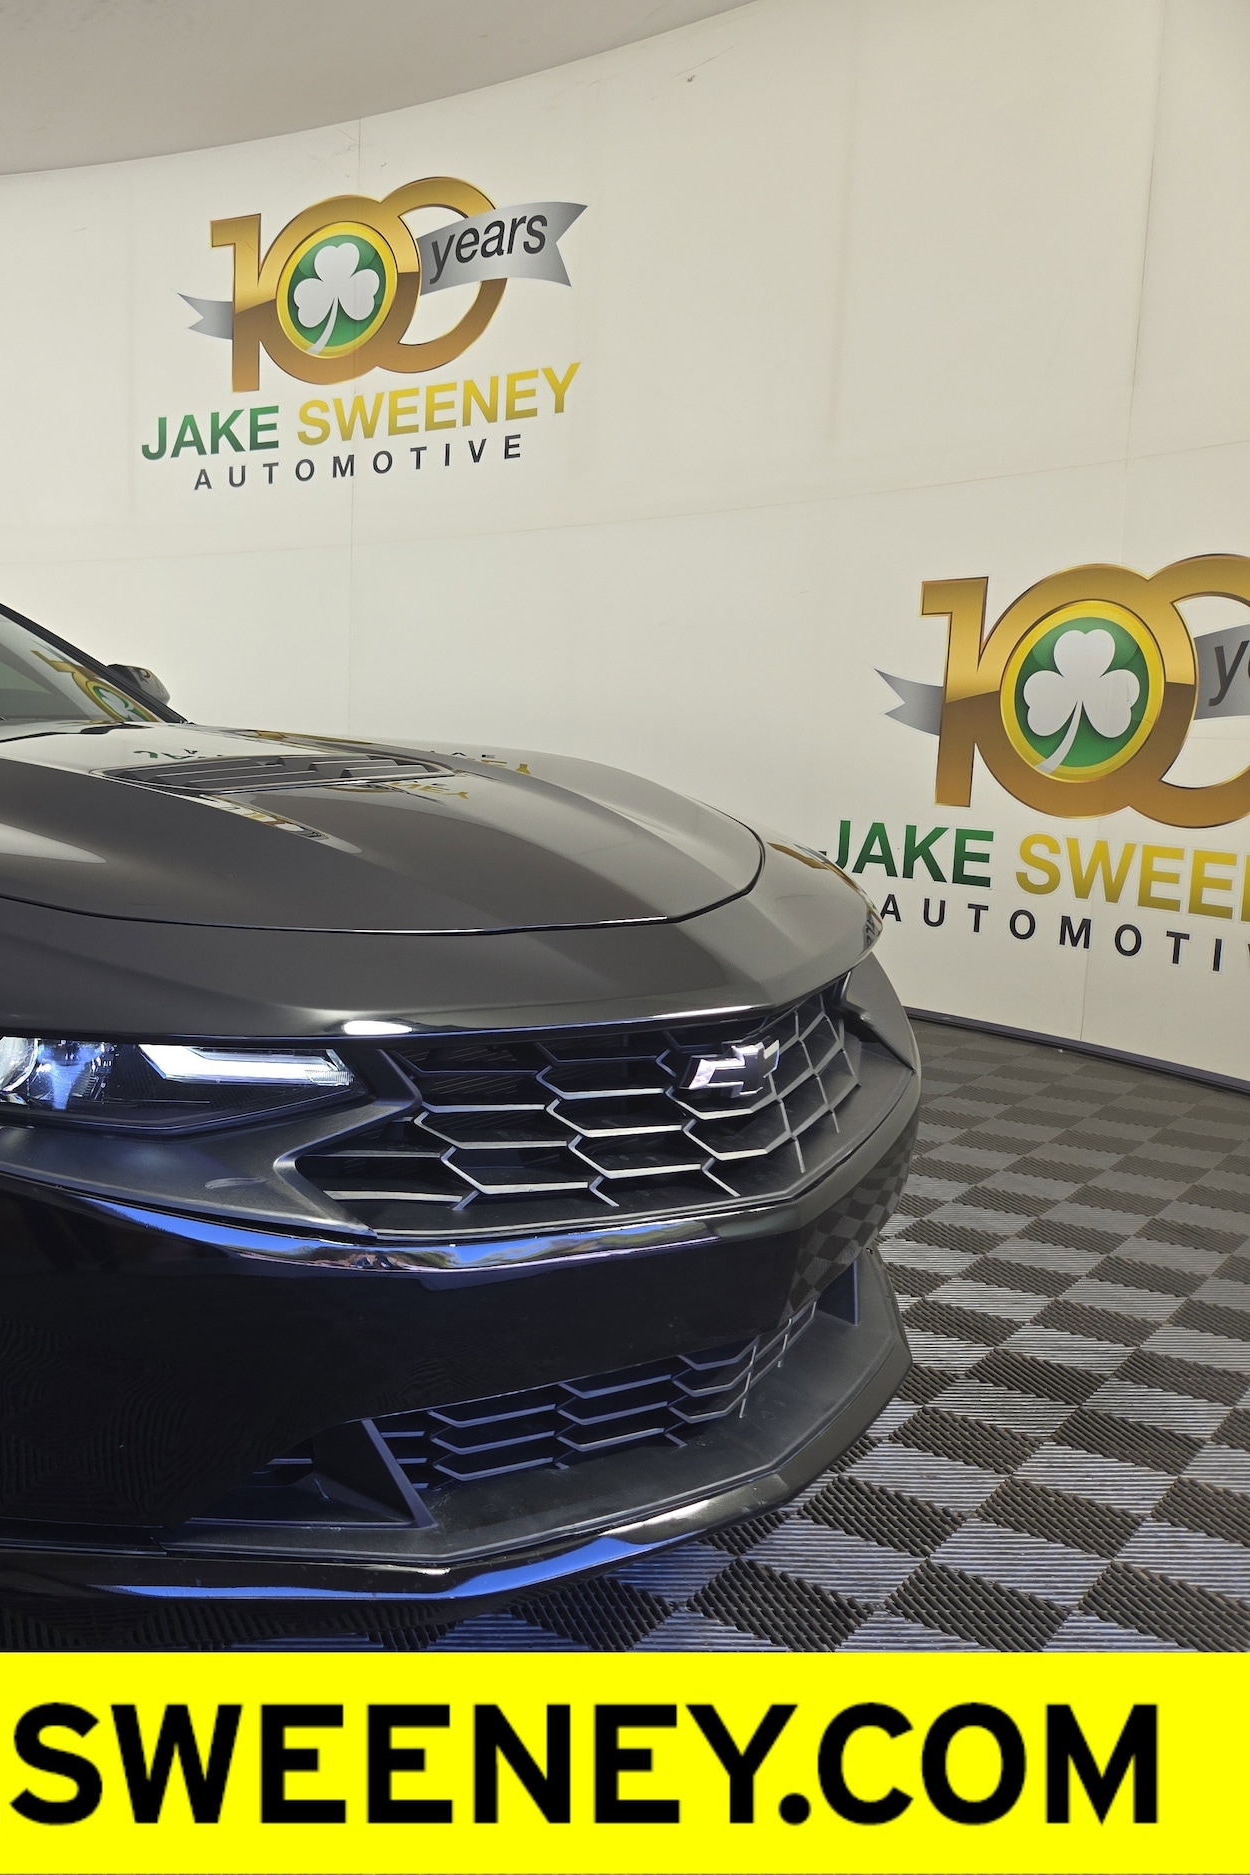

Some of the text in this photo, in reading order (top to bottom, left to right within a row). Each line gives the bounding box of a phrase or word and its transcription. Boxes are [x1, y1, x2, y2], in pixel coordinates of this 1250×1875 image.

[210, 176, 548, 393] 100 years
[141, 362, 582, 461] JAKE SWEENEY
[193, 434, 522, 491] AUTOMOTIVE
[817, 820, 1250, 923] JAKE SWEE
[880, 893, 1250, 972] AUTOMOTI
